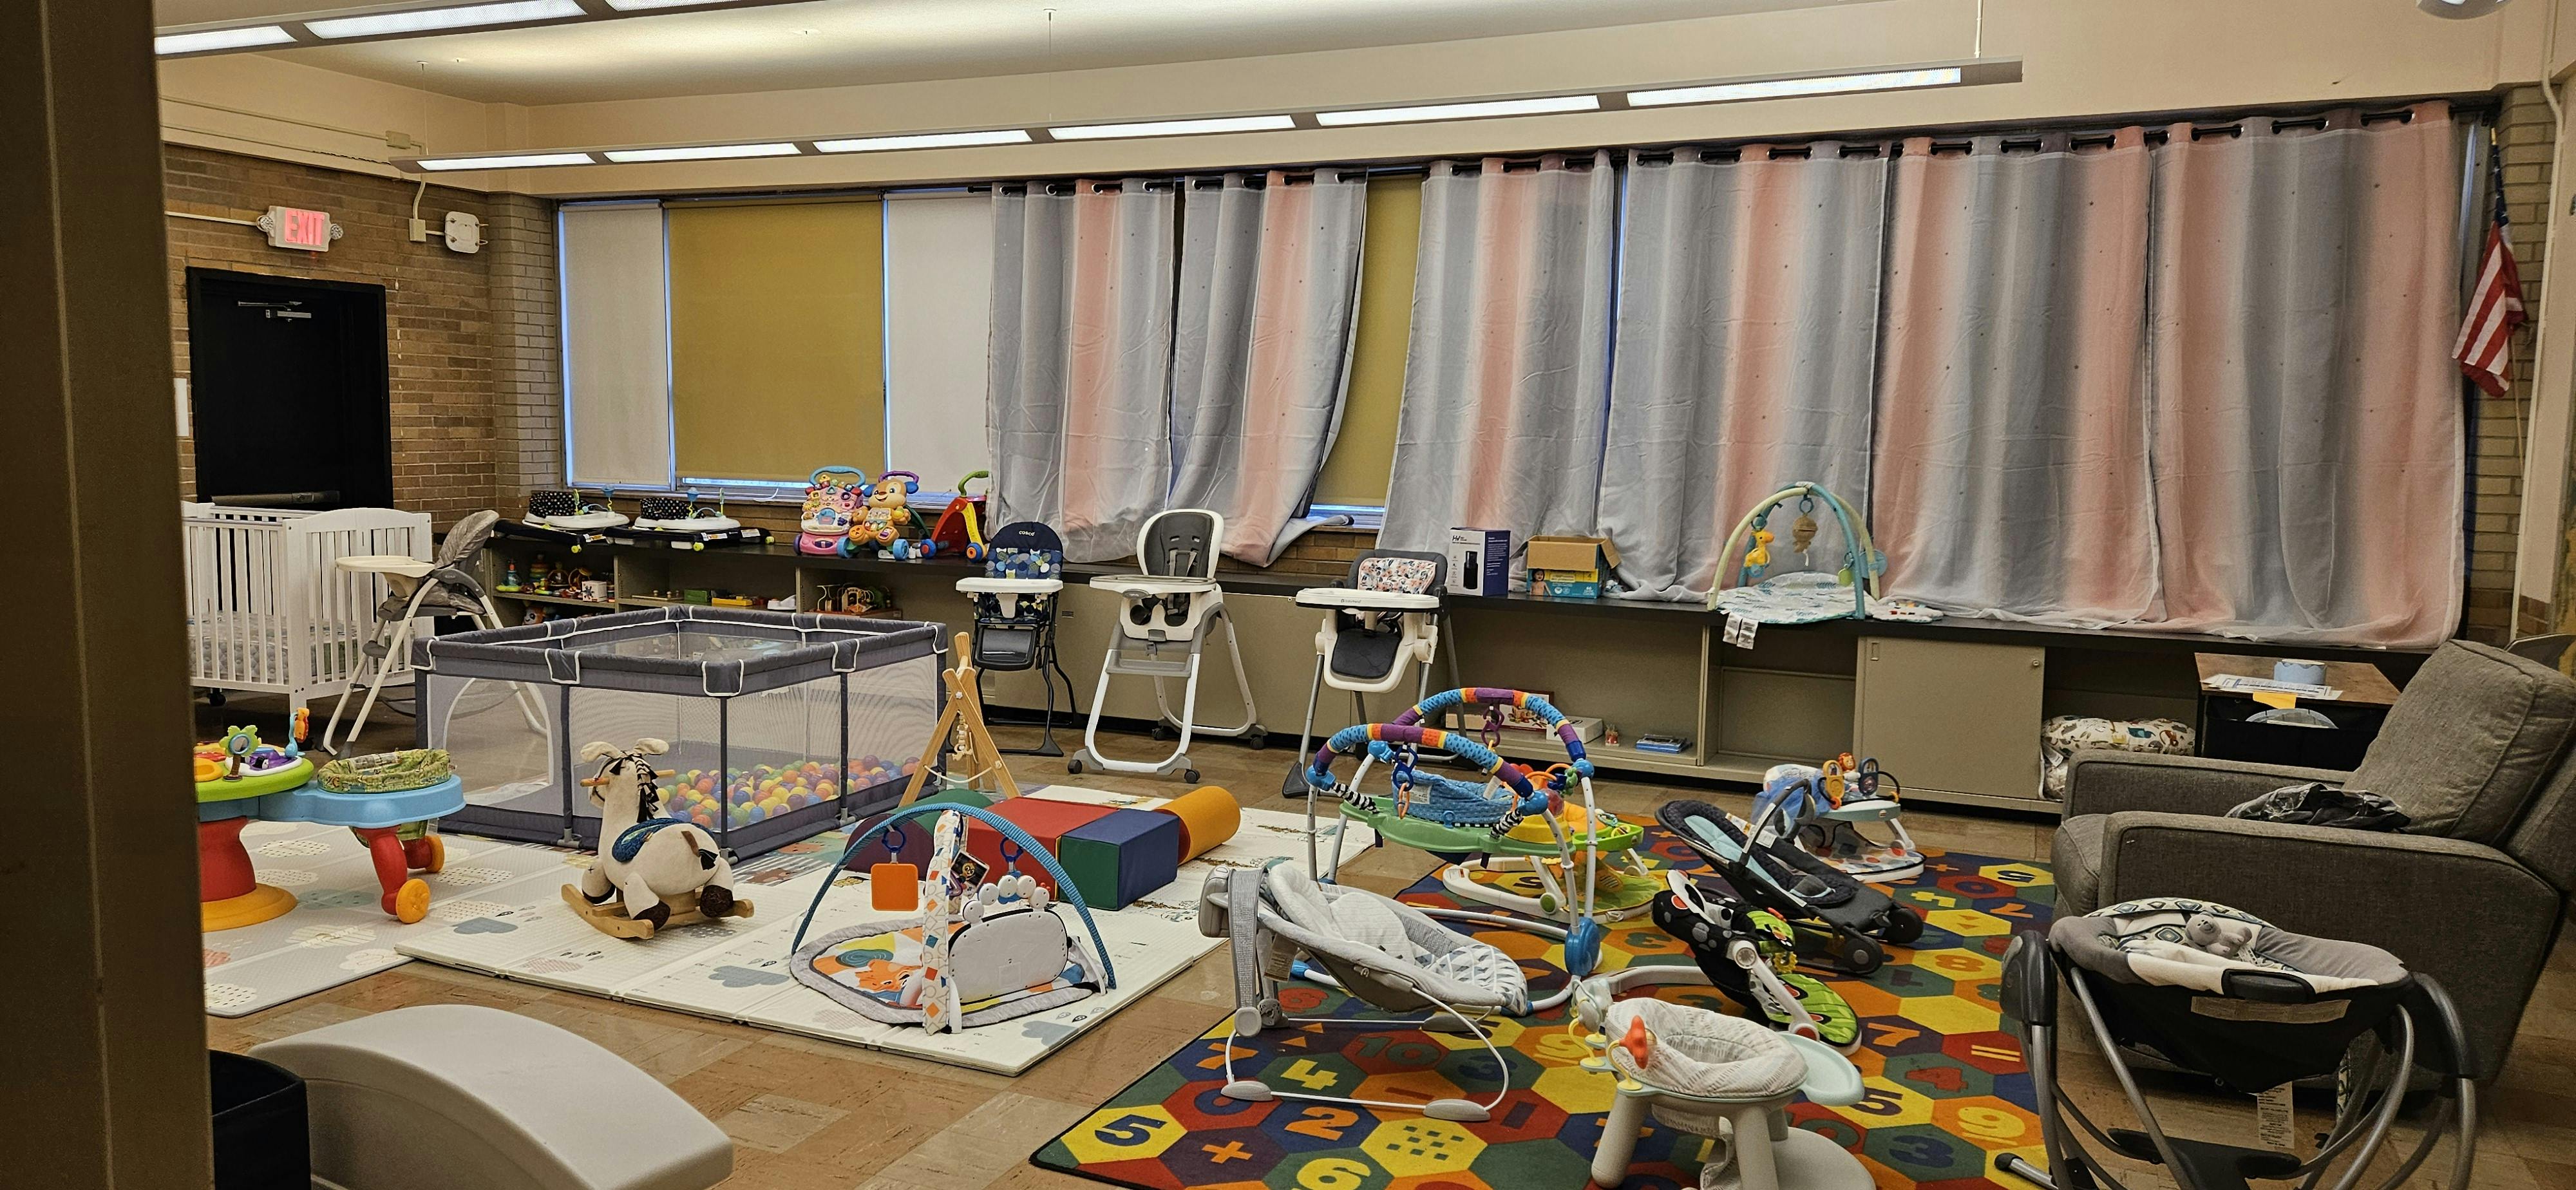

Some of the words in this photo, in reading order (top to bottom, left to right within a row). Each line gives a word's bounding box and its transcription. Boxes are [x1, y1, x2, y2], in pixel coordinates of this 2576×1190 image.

[285, 209, 325, 246] EXIT
[1354, 1037, 1442, 1066] 10
[1281, 1059, 1338, 1090] 4
[1095, 1114, 1167, 1146] 5
[1284, 1106, 1359, 1140] 2
[1296, 1158, 1371, 1190] 6
